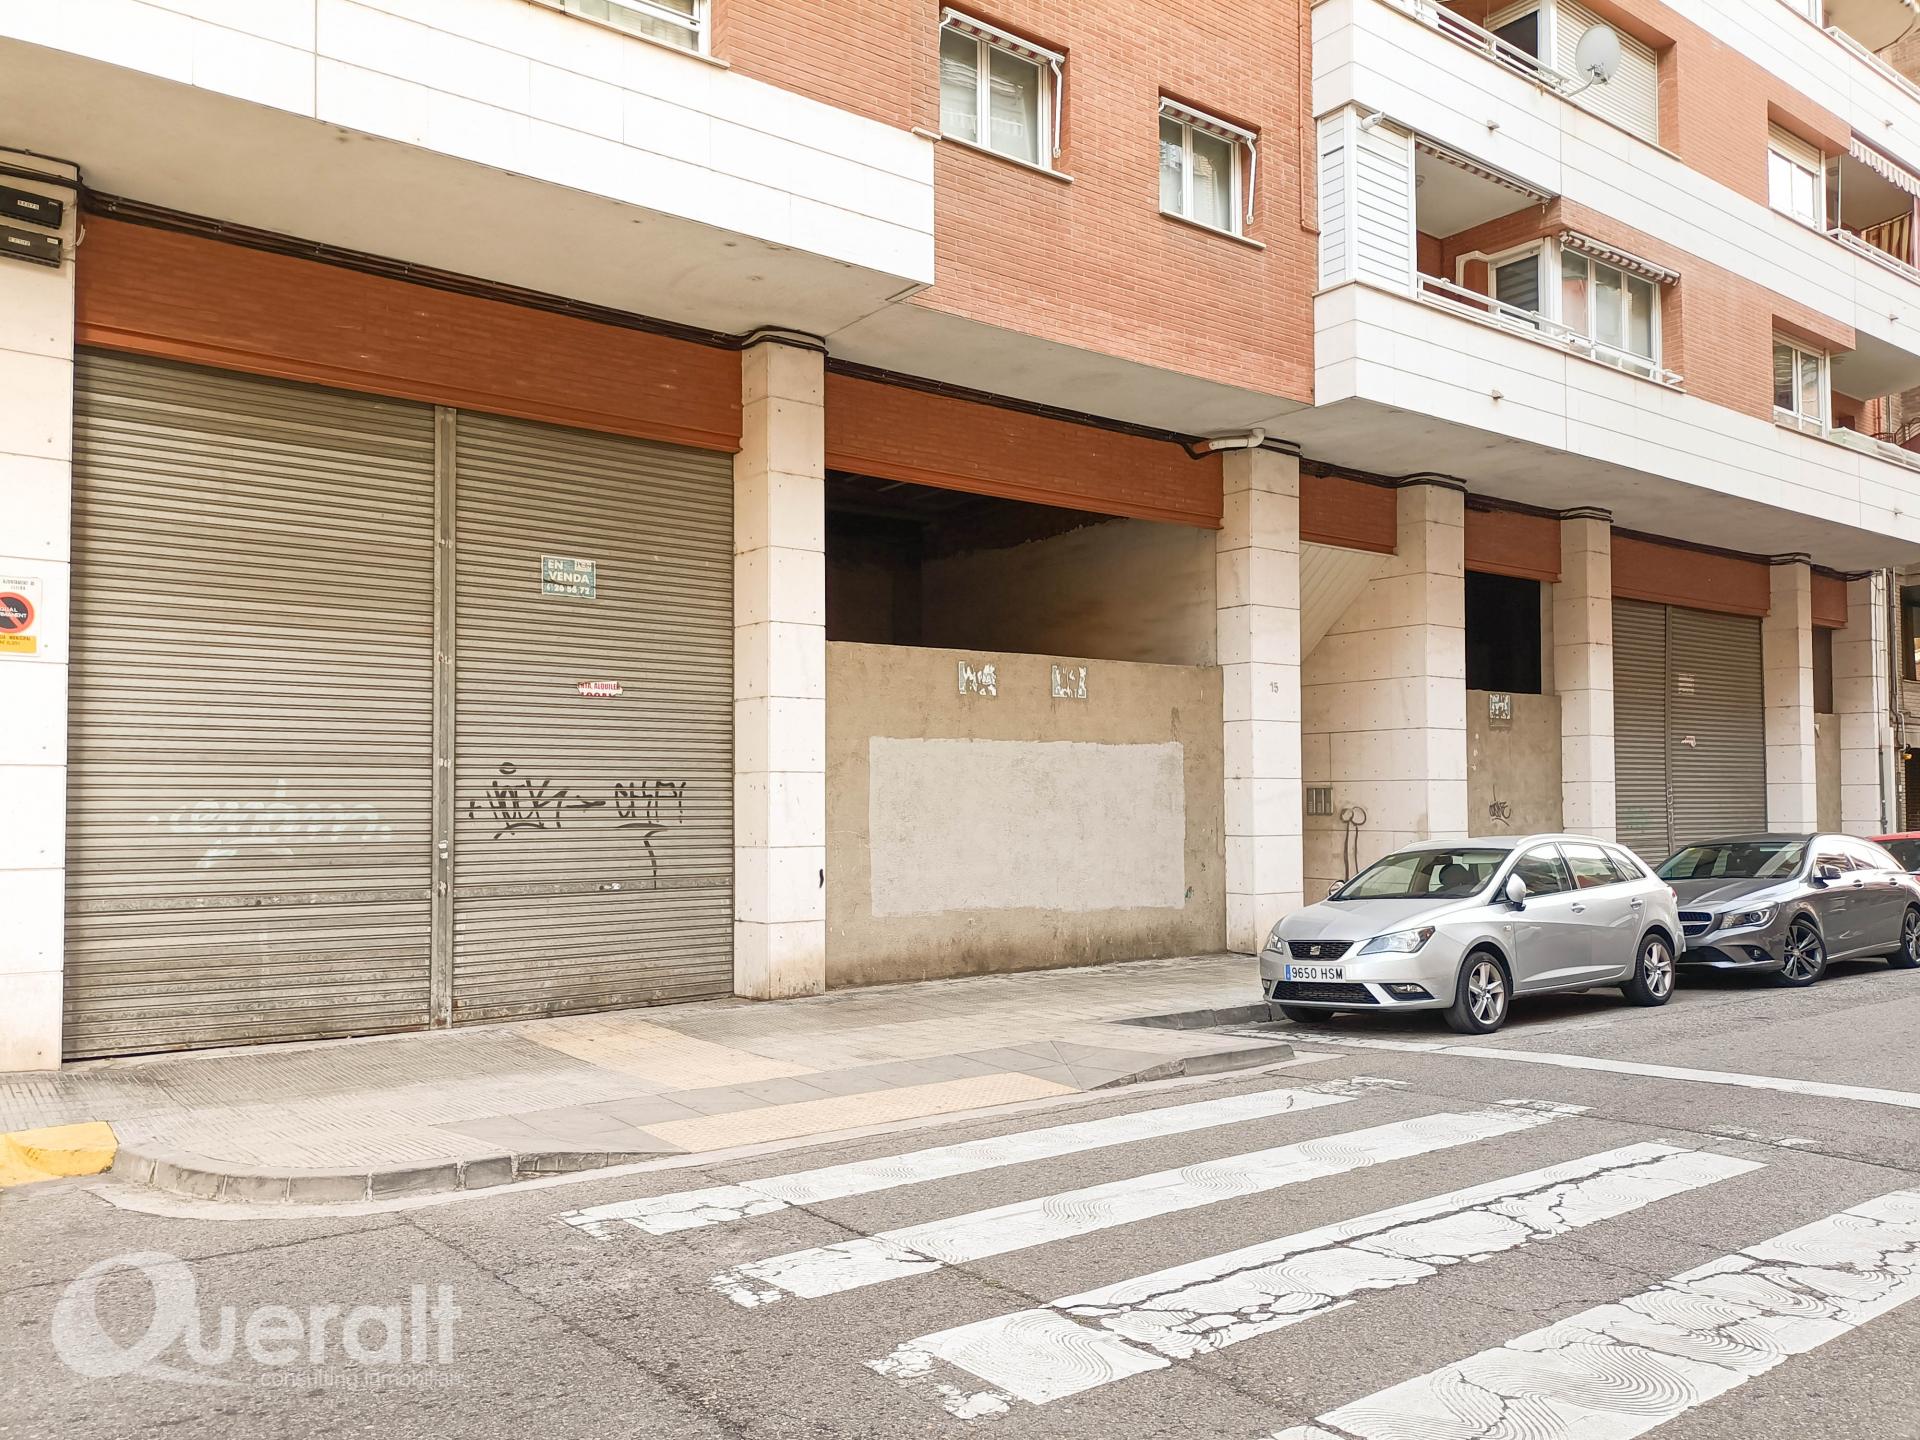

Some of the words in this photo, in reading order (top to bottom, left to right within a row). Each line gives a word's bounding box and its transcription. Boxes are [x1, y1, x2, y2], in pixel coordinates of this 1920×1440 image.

[547, 559, 564, 570] EN
[548, 570, 590, 585] VENDA
[1269, 681, 1279, 694] 15
[1291, 967, 1317, 979] 9650
[1321, 968, 1343, 980] HSM
